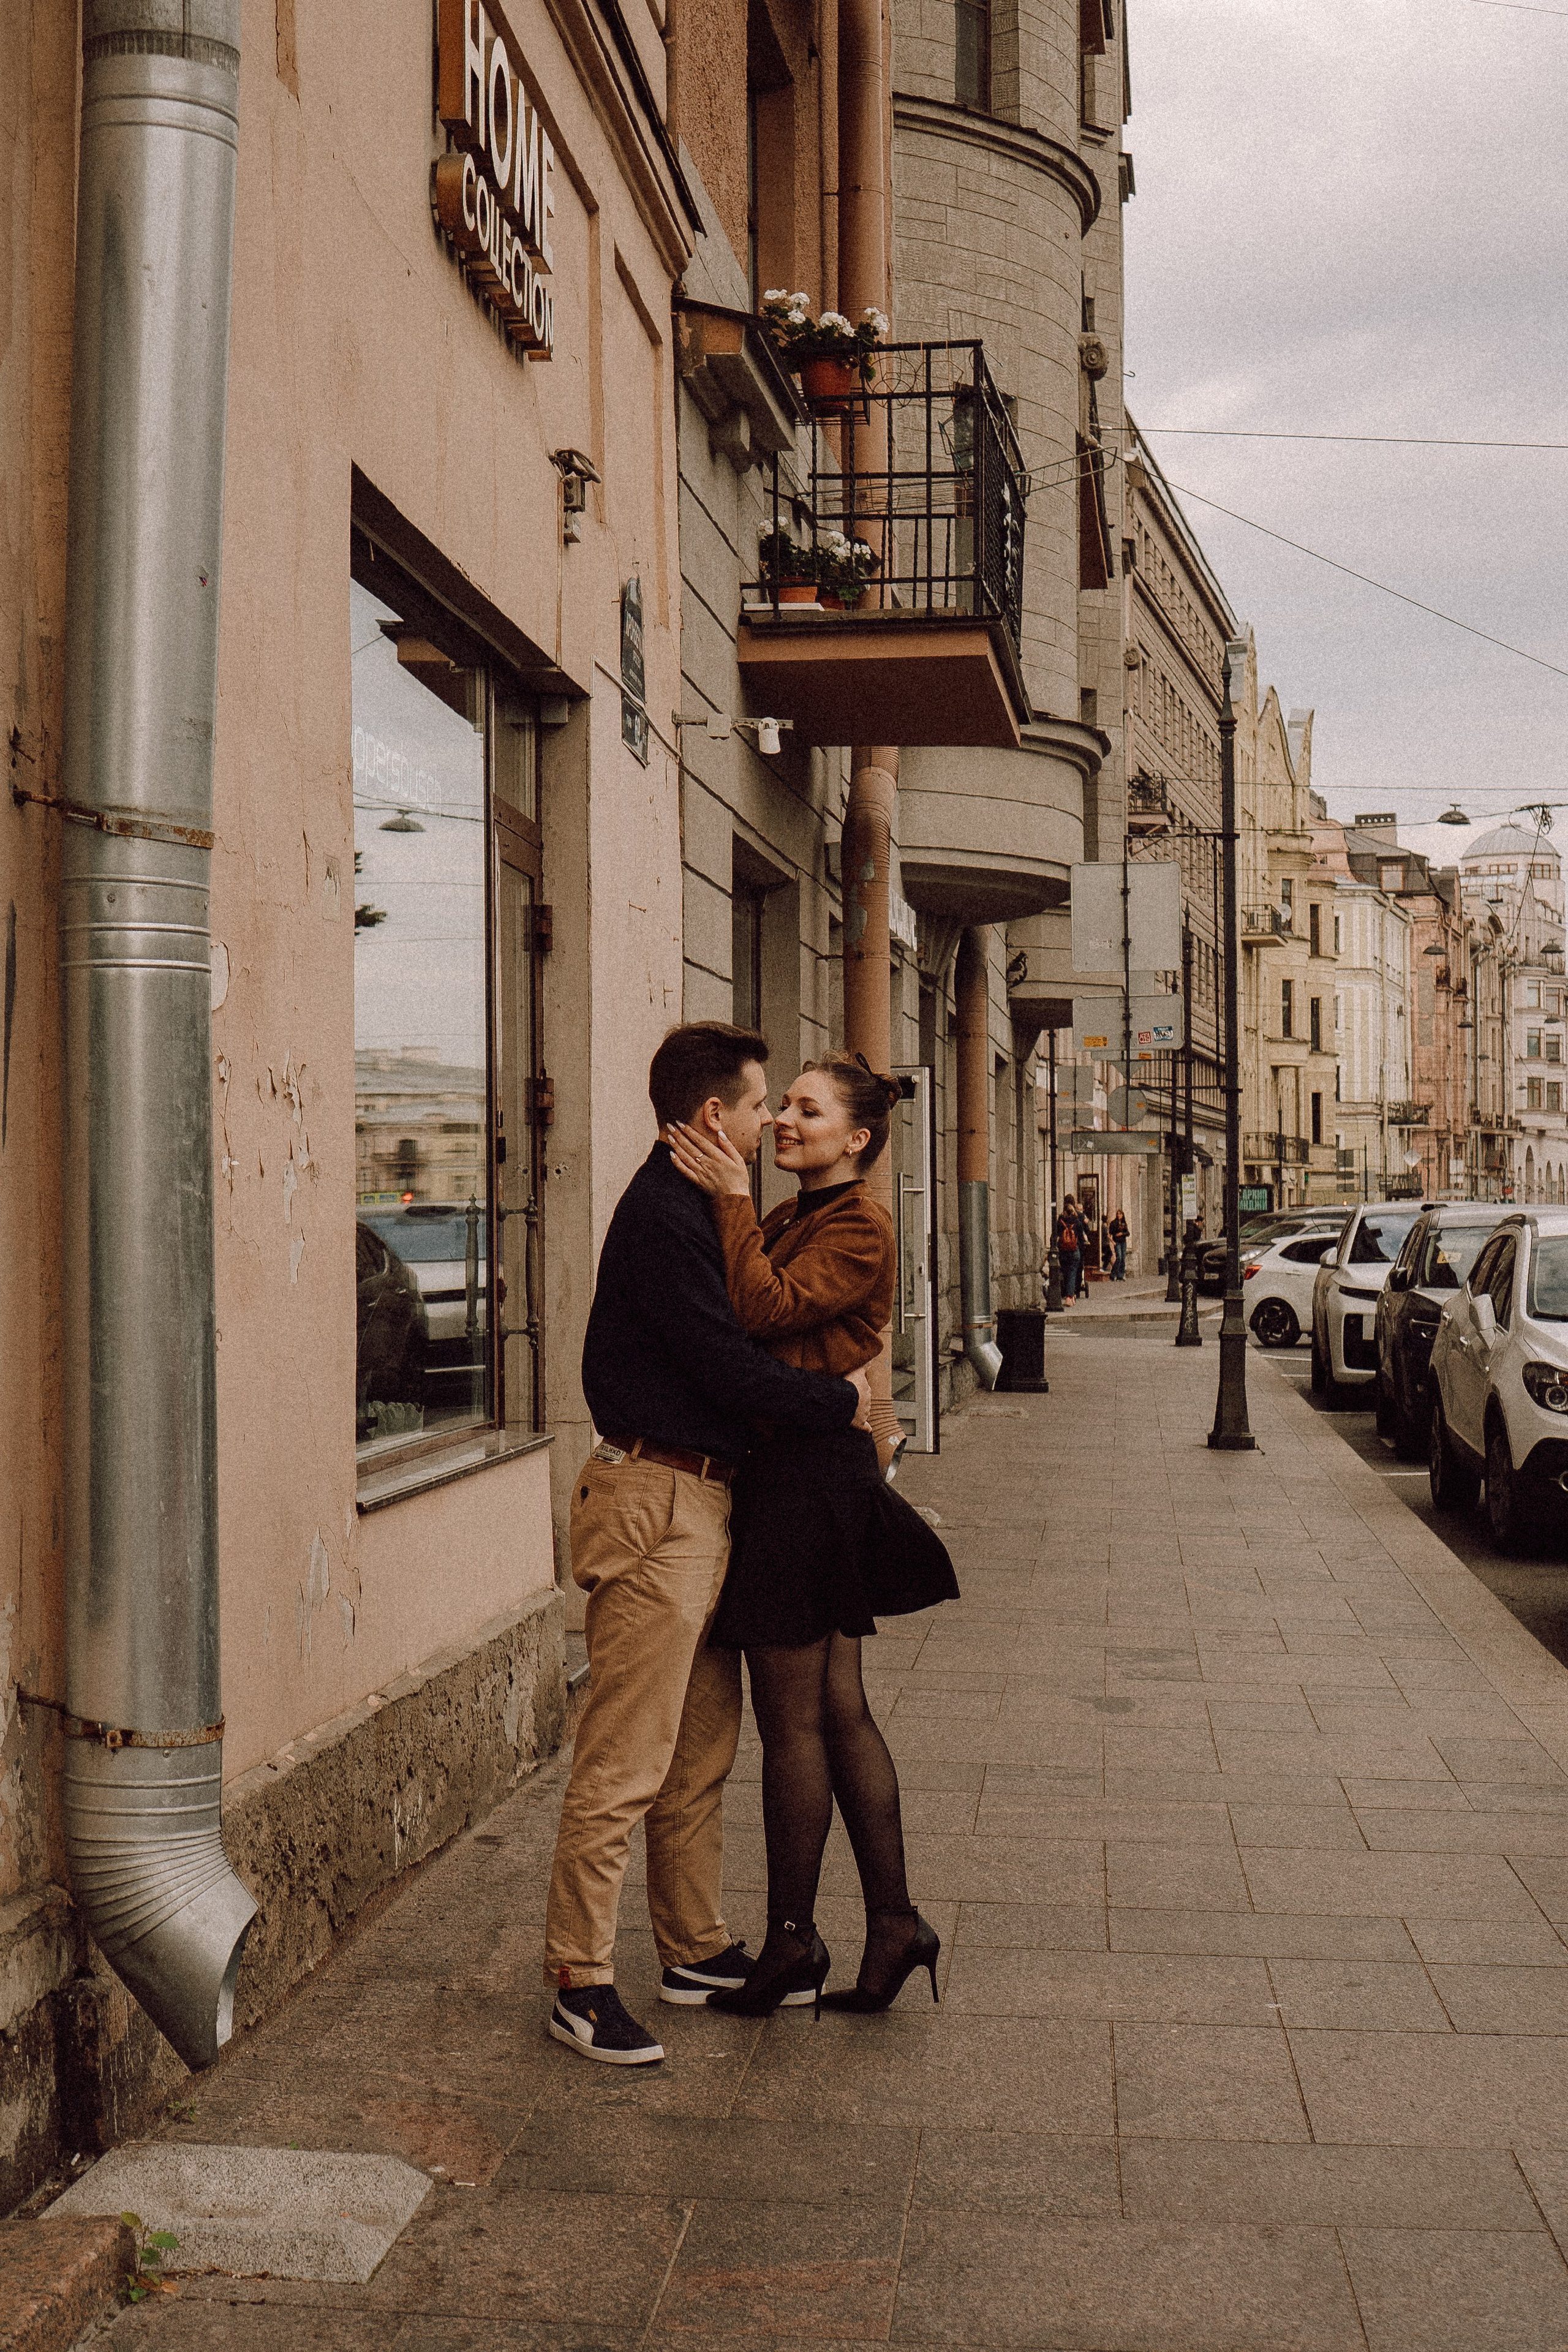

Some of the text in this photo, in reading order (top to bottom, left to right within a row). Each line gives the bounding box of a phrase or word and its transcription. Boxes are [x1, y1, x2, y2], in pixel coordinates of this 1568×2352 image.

[464, 0, 554, 274] HOME
[462, 153, 554, 350] COLLECTION
[353, 724, 442, 818] ppersbusch
[1238, 1200, 1267, 1212] ИНДЖИ
[1242, 1189, 1267, 1200] АРХИП
